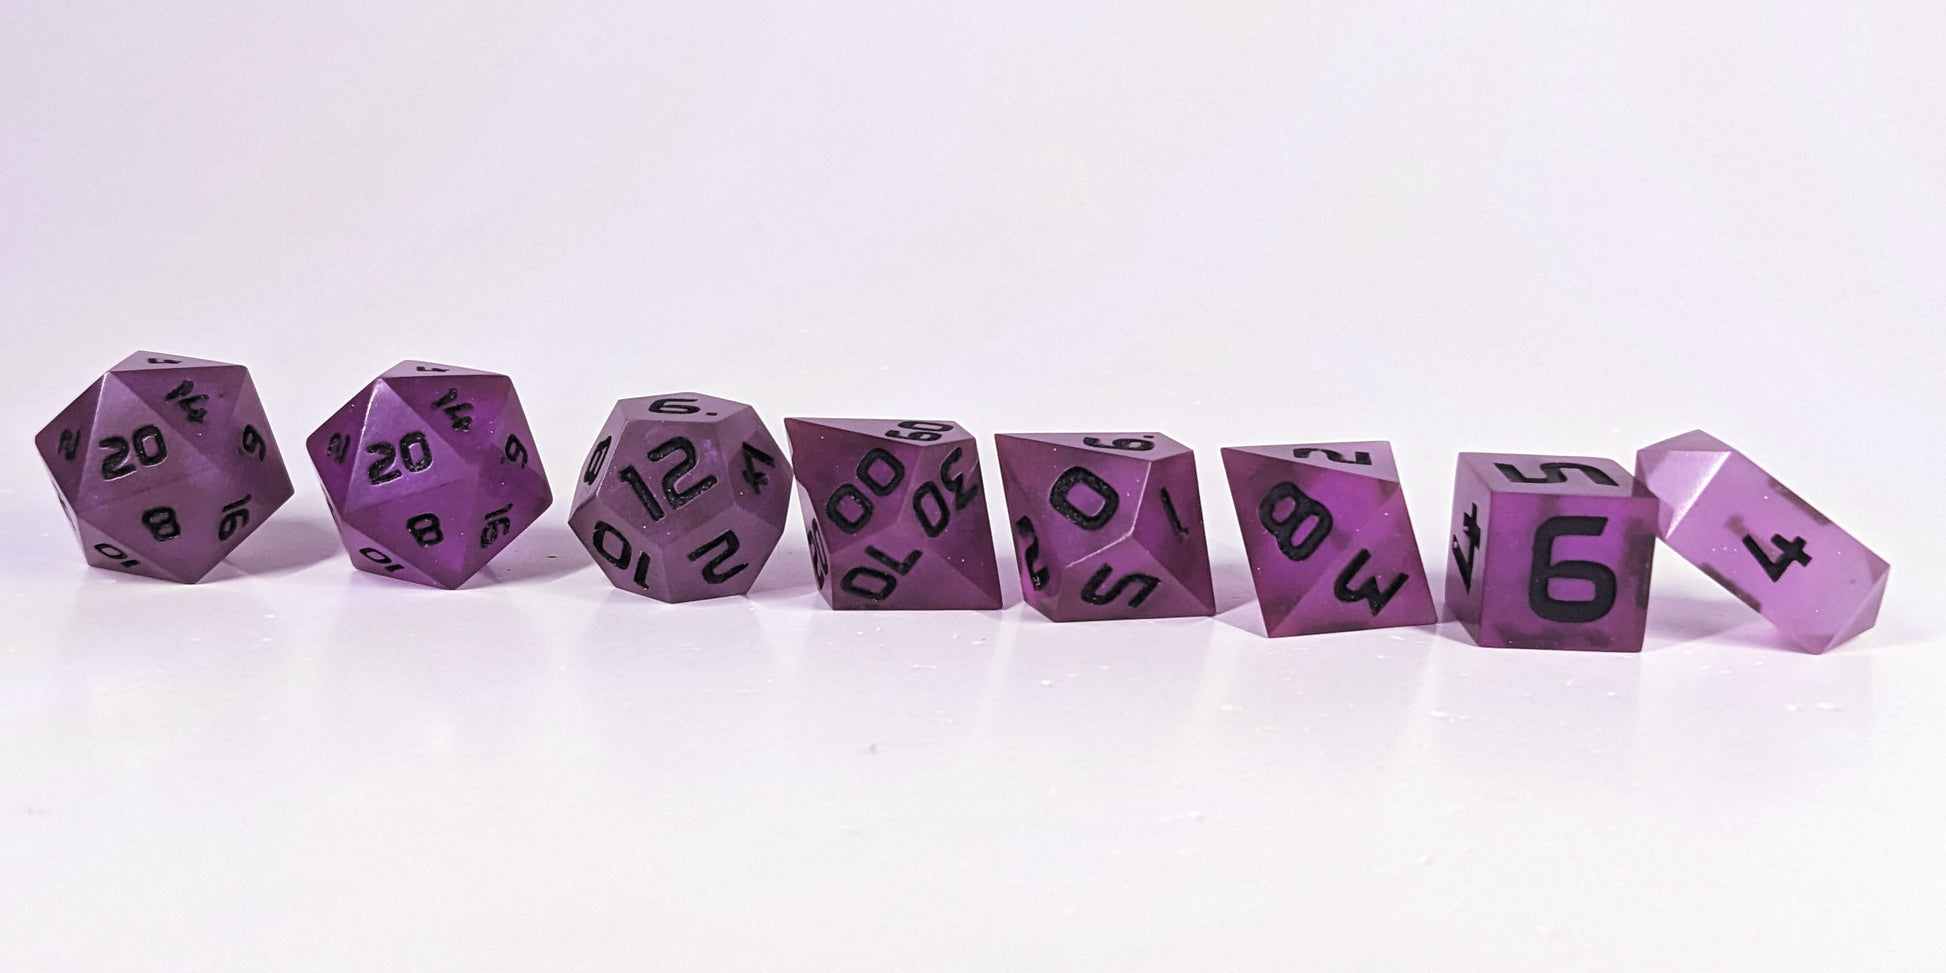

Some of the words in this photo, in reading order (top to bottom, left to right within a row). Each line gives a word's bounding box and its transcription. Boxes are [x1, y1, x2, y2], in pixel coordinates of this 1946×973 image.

[164, 380, 209, 423] 14
[431, 388, 474, 432] 14
[98, 424, 169, 481] 20
[366, 430, 433, 486] 20
[618, 436, 719, 522] 12
[1493, 462, 1620, 487] 5
[218, 494, 252, 541] 16
[825, 447, 906, 535] 00
[912, 447, 979, 538] 30
[1050, 466, 1120, 531] 0
[1160, 486, 1189, 535] 1
[141, 506, 181, 542] 8
[406, 513, 444, 548] 8
[480, 503, 514, 549] 16
[1258, 481, 1334, 562] 8
[1451, 502, 1481, 596] 4
[592, 520, 651, 590] 10
[1334, 548, 1410, 617] 3
[1528, 515, 1617, 624] 6
[1741, 533, 1813, 583] 4
